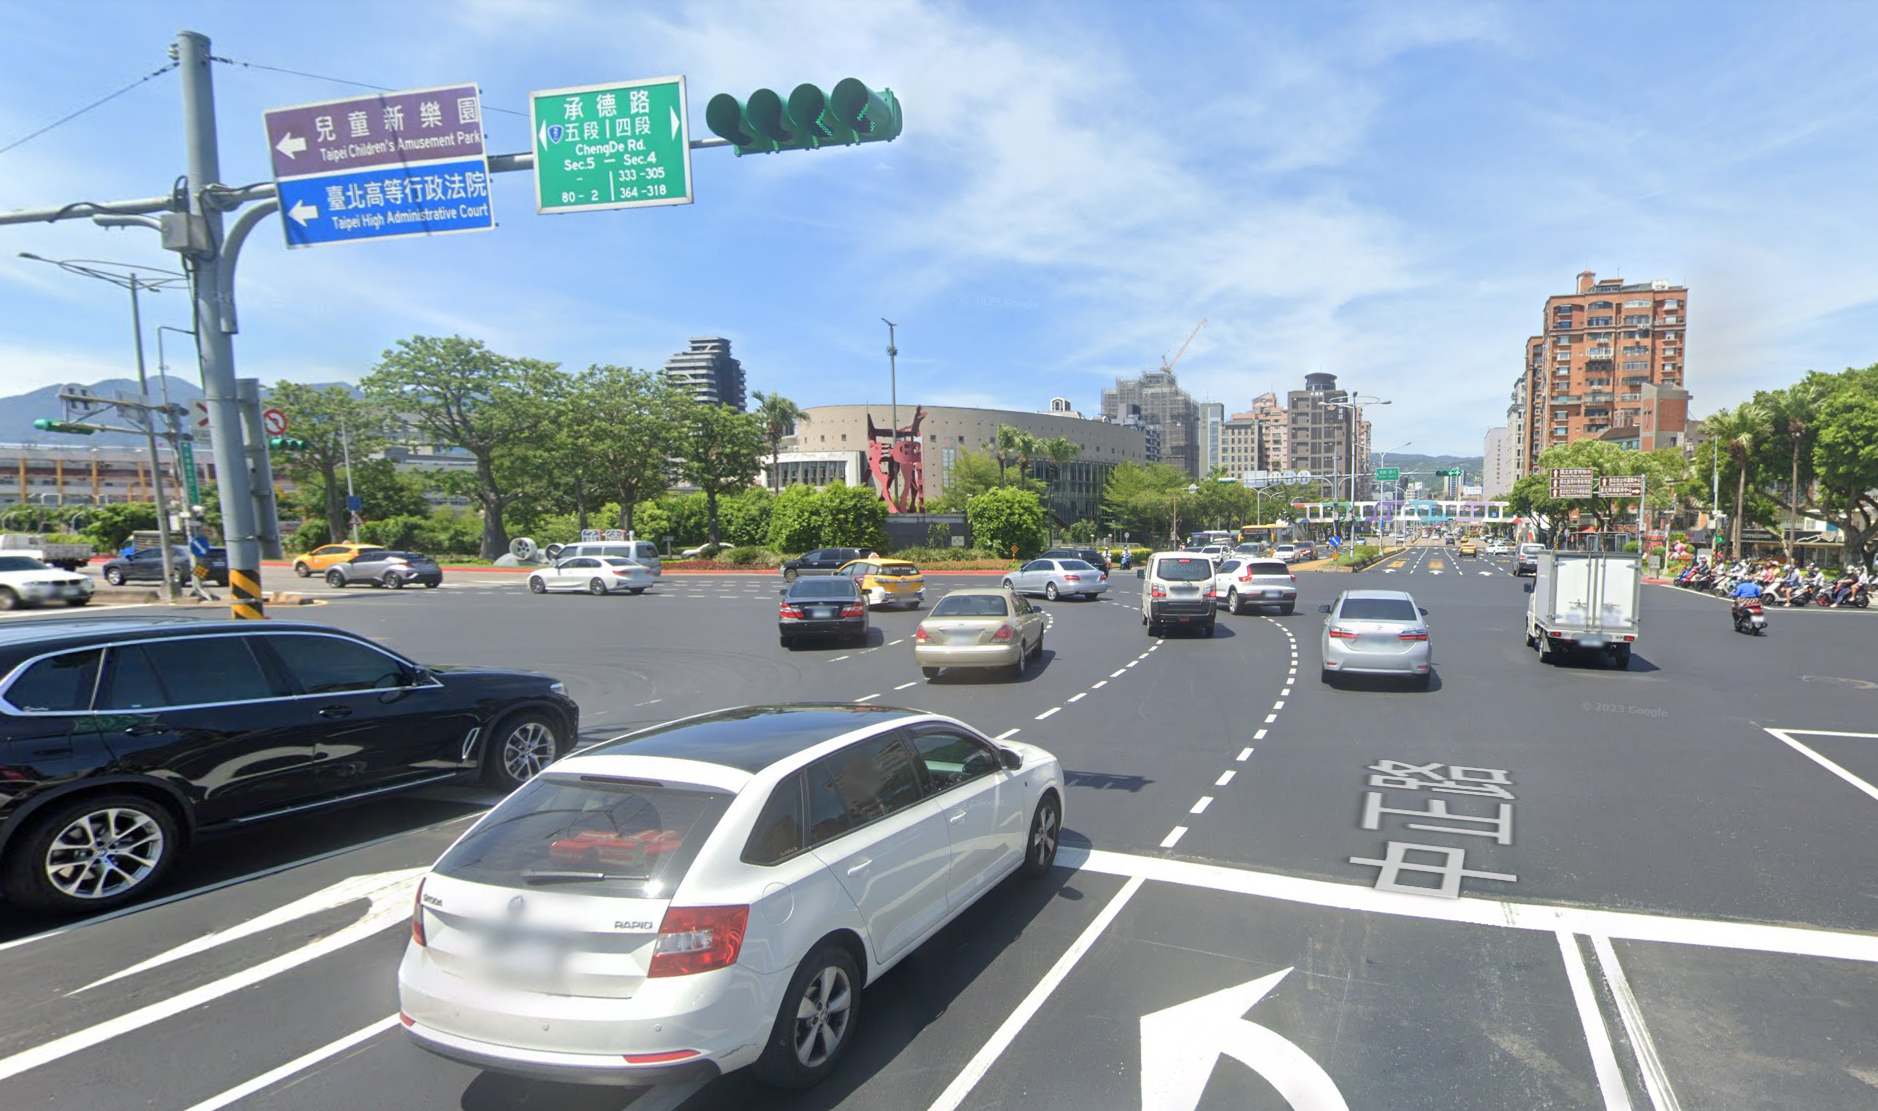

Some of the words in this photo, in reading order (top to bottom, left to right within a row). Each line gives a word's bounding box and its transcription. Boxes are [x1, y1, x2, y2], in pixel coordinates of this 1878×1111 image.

[563, 90, 650, 120] 承德路
[315, 97, 479, 143] 兒童新樂園
[565, 121, 599, 142] 五段
[615, 116, 651, 137] 四段
[320, 146, 347, 162] Taipei
[349, 140, 395, 157] Children's
[397, 133, 455, 150] Amusement
[457, 130, 481, 144] Park
[575, 141, 625, 157] ChengDe
[627, 139, 646, 150] Rd.
[564, 157, 596, 171] Sec.5
[623, 151, 657, 166] Sec.4
[325, 171, 487, 211] 臺北高等行政法院
[332, 214, 361, 231] Taipei
[362, 213, 385, 229] High
[386, 207, 457, 224] Administrative
[459, 204, 489, 218] Court
[614, 920, 654, 930] RAPID
